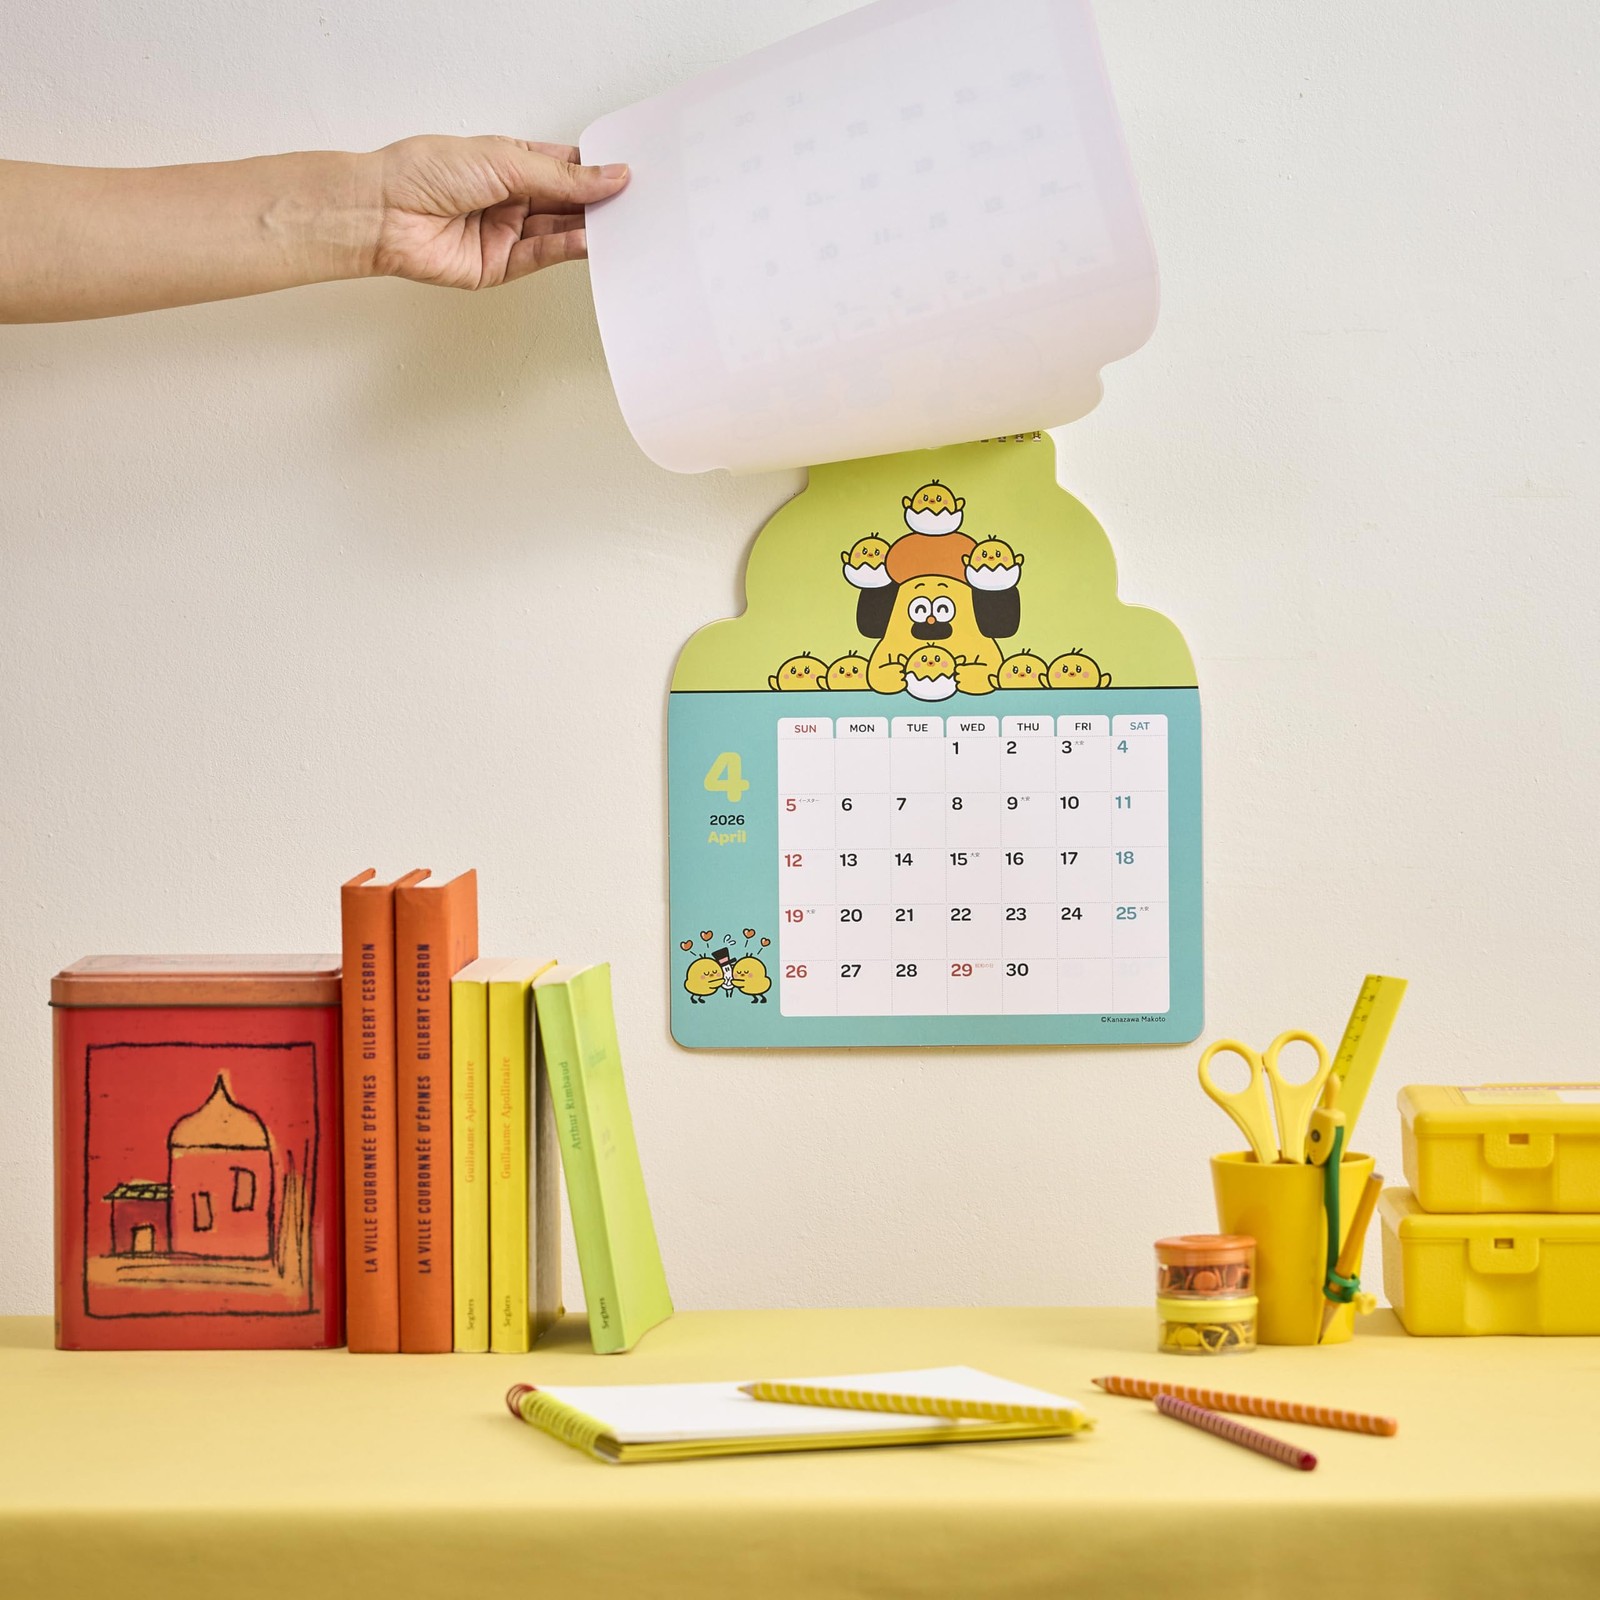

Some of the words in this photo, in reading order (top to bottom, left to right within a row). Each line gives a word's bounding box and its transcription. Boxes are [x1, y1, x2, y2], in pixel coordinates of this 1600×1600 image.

[794, 724, 817, 733] SUN
[849, 724, 875, 733] MON
[906, 723, 929, 732] TUE
[959, 723, 986, 732] WED
[1016, 723, 1040, 732] THU
[1075, 722, 1092, 731] FRI
[1130, 722, 1150, 731] SAT
[952, 741, 959, 755] 1
[1006, 740, 1017, 755] 2
[1061, 740, 1073, 754] 3
[1117, 740, 1129, 753] 4
[704, 752, 750, 803] 4
[709, 814, 745, 826] 2026
[786, 798, 797, 812] 5
[841, 797, 853, 812] 6
[896, 797, 907, 811] 7
[951, 796, 963, 811] 8
[1006, 796, 1018, 810] 9
[1059, 795, 1080, 810] 10
[1115, 795, 1132, 809] 11
[708, 829, 747, 846] April
[784, 853, 803, 868] 12
[839, 853, 858, 867] 13
[894, 852, 914, 867] 14
[949, 852, 968, 867] 15
[1005, 851, 1025, 866] 16
[1060, 851, 1079, 866] 17
[1115, 851, 1134, 865] 18
[785, 909, 804, 923] 19
[840, 908, 863, 923] 20
[895, 908, 914, 922] 21
[950, 907, 972, 922] 22
[1005, 907, 1027, 922] 23
[1061, 906, 1083, 921] 24
[1116, 906, 1137, 920] 25
[361, 943, 376, 1002] CESBRON
[416, 943, 430, 1002] CESBRON
[785, 964, 808, 979] 26
[840, 964, 862, 978] 27
[895, 963, 918, 978] 28
[951, 963, 973, 977] 29
[1005, 962, 1029, 977] 30
[362, 1007, 376, 1060] GILBERT
[416, 1007, 431, 1061] GILBERT
[1141, 1015, 1166, 1023] Makoto
[464, 1060, 477, 1122] Apollinaire
[500, 1056, 513, 1119] Apollinaire
[558, 1060, 576, 1110] Rimbaud
[569, 1113, 581, 1150] Arthur
[464, 1126, 475, 1183] Guillaume
[500, 1122, 512, 1180] Guillaume
[361, 1137, 377, 1214] COURONNÉE
[415, 1138, 431, 1214] COURONNÉE
[364, 1217, 378, 1254] VILLE
[418, 1218, 432, 1254] VILLE
[364, 1257, 378, 1274] LA
[418, 1258, 432, 1274] LA
